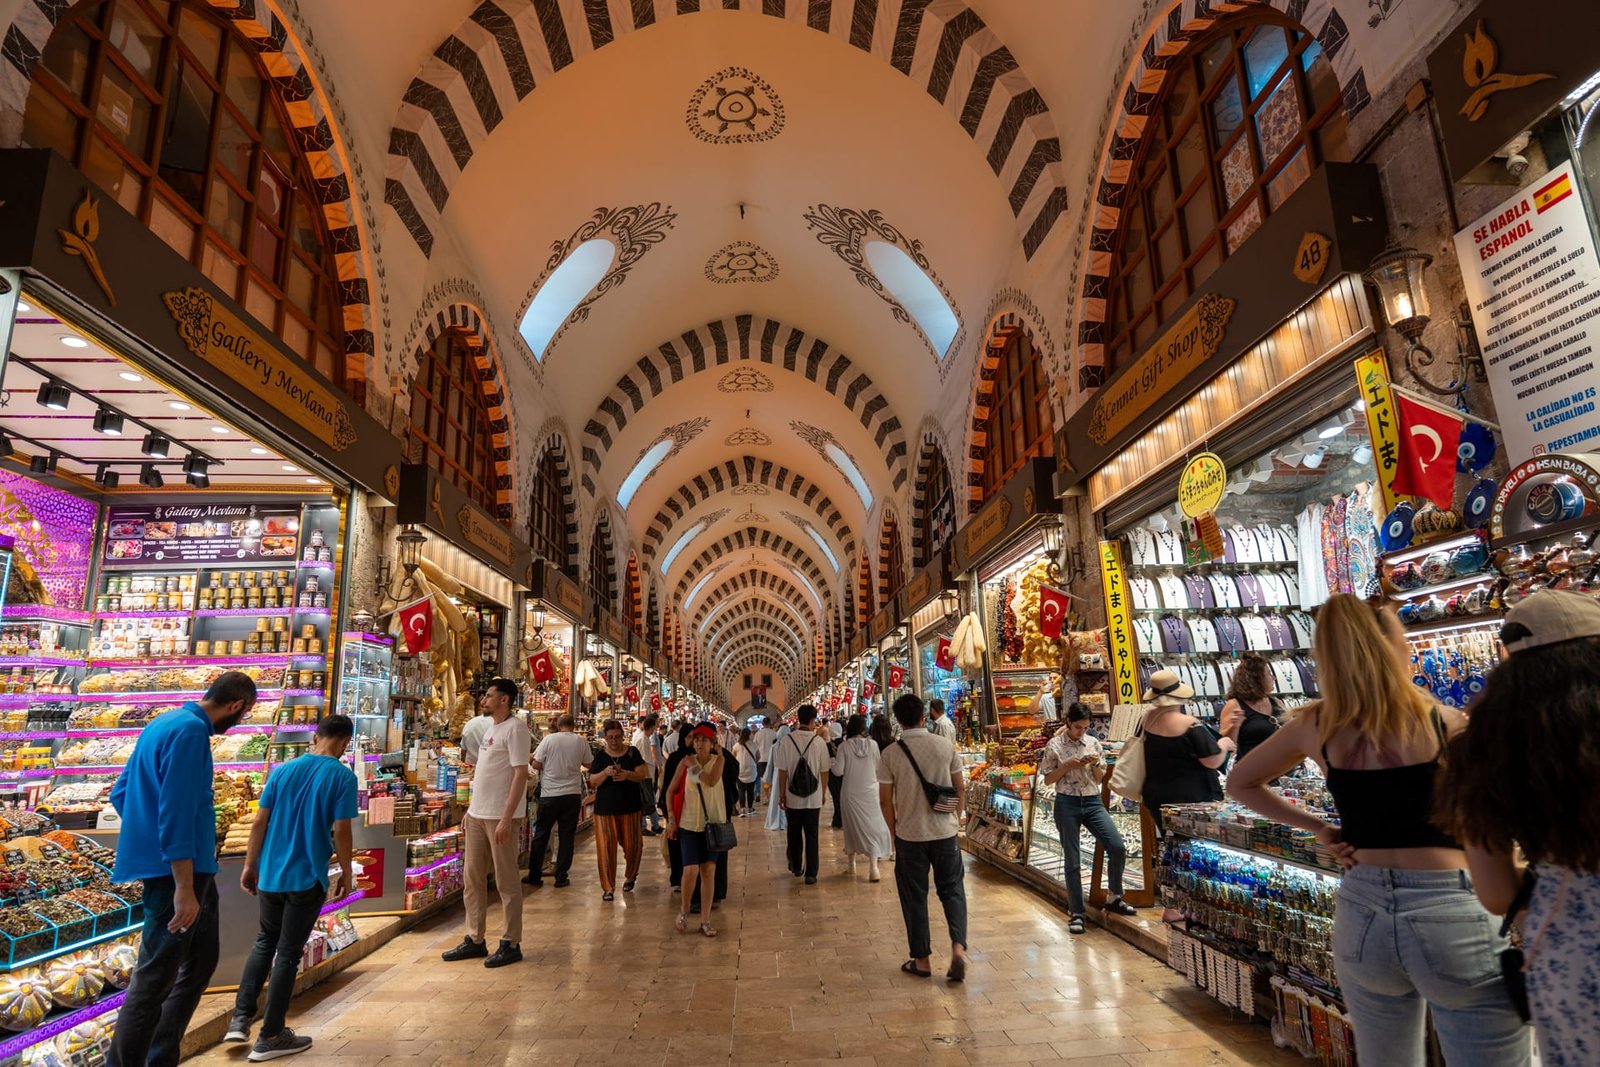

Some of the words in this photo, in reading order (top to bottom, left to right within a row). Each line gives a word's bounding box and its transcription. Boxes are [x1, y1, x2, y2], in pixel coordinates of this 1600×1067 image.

[1473, 226, 1489, 244] SE
[1489, 199, 1531, 234] HABLA
[1479, 219, 1533, 261] ESPANOL
[1300, 241, 1321, 271] 48
[1481, 261, 1503, 278] TENEMOS
[1502, 250, 1521, 268] VENENO
[1522, 242, 1536, 256] PARA
[1536, 236, 1542, 248] LA
[1542, 226, 1564, 244] SUEGRA
[1493, 276, 1501, 287] UN
[1500, 264, 1522, 283] POQUITO
[1522, 260, 1529, 271] DE
[1529, 255, 1540, 268] POR
[1540, 246, 1557, 262] FAVOR
[1483, 290, 1502, 308] MADRID
[1502, 286, 1509, 299] AL
[1526, 272, 1534, 285] DE
[1533, 258, 1561, 281] MOSTOLES
[1560, 254, 1568, 267] AL
[1568, 246, 1585, 264] SUELO
[1490, 299, 1518, 319] BARCELONA
[1518, 292, 1532, 306] BONA
[1538, 284, 1546, 296] LA
[1546, 276, 1561, 291] BONA
[1560, 269, 1576, 283] SONA
[1547, 291, 1569, 306] MENGEN
[1489, 355, 1500, 366] CON
[1539, 330, 1551, 343] NUN
[1559, 319, 1575, 333] FALTA
[1503, 334, 1509, 345] LA
[1509, 324, 1533, 341] MANZANA
[1509, 360, 1526, 372] NUNCA
[1544, 342, 1562, 357] MANDA
[1562, 330, 1586, 348] CARALLO
[212, 321, 273, 385] Gallery
[274, 369, 335, 427] Mevlana
[1106, 381, 1140, 421] Cennet
[1142, 355, 1164, 393] Gift
[1167, 327, 1198, 370] Shop
[1511, 374, 1529, 387] TERUEL
[1546, 357, 1568, 373] HUESCA
[1568, 346, 1592, 363] TAMBIEN
[1517, 387, 1536, 400] MUCHO
[1548, 372, 1568, 388] LOPERA
[1526, 410, 1536, 422] LA
[1572, 392, 1584, 405] NO
[1584, 386, 1596, 398] ES
[1533, 422, 1543, 433] LA
[1563, 460, 1588, 479] BABA
[165, 506, 200, 518] Gallery
[201, 505, 246, 516] Mevlana
[1528, 484, 1555, 510] CAVIAR
[1106, 559, 1134, 705] エドまっちゃんの
